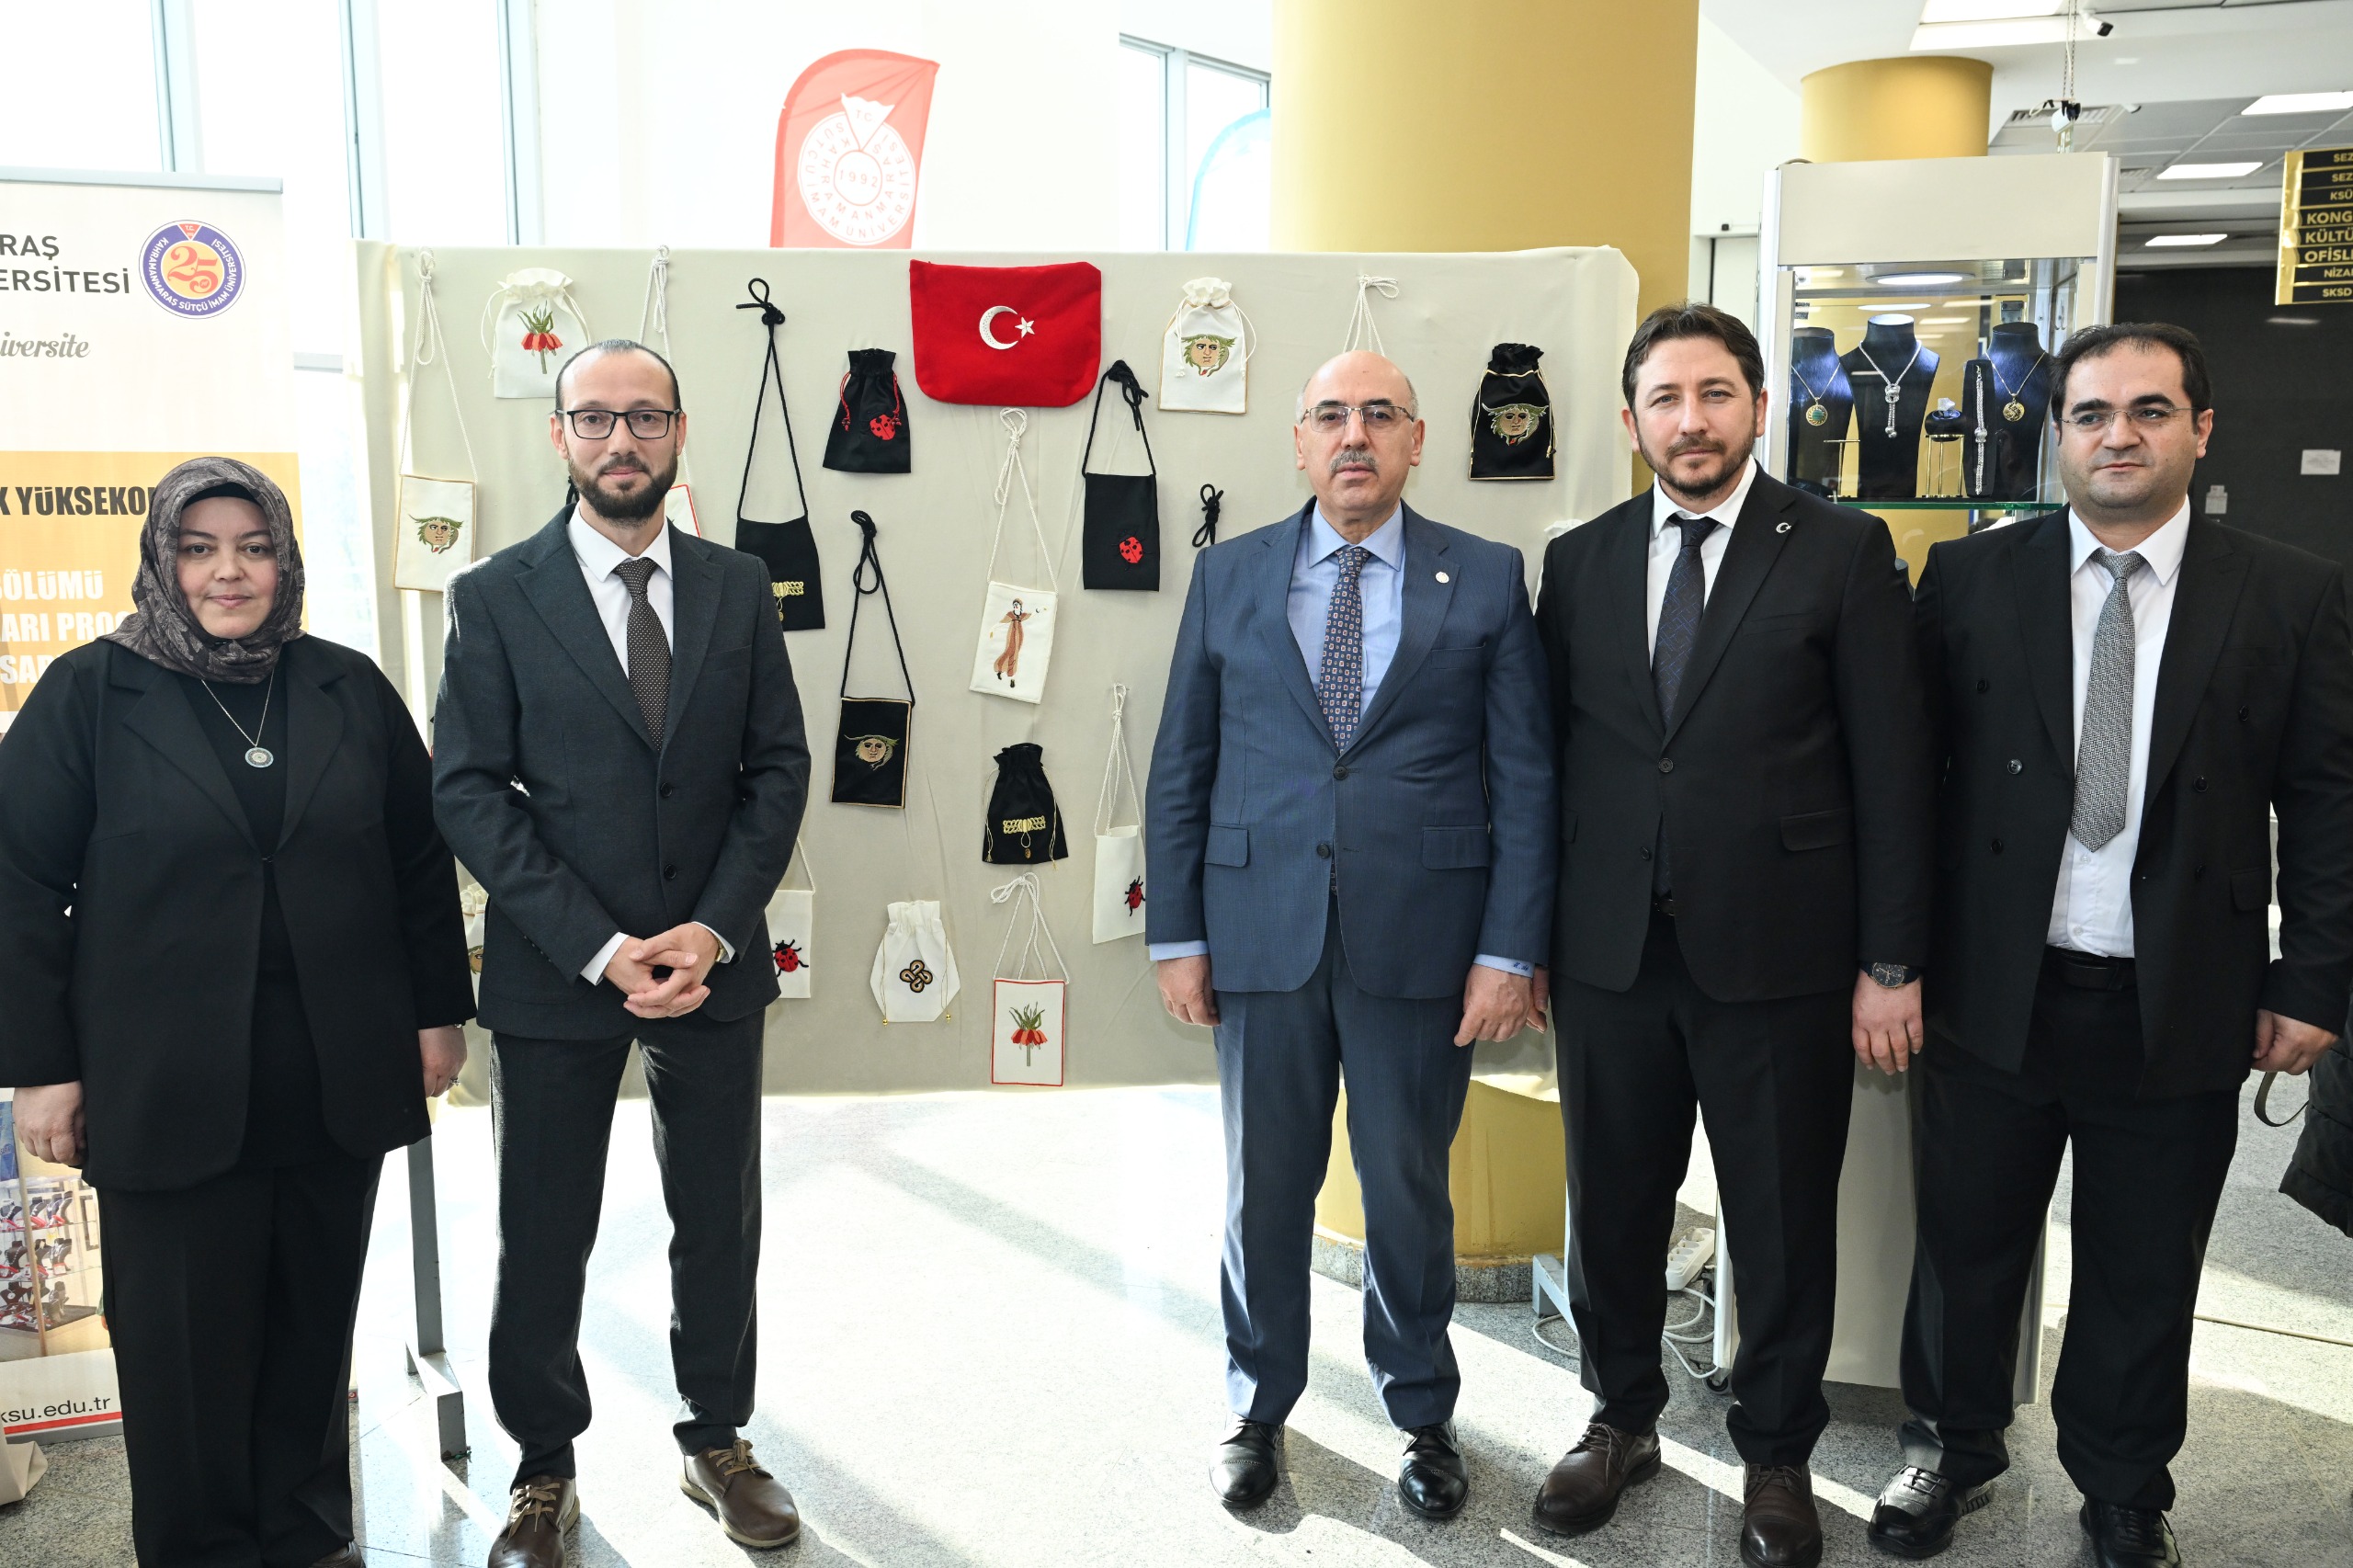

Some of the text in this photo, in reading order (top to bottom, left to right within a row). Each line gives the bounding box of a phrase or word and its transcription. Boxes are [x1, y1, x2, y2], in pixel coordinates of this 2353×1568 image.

[839, 169, 878, 187] 1992
[2330, 188, 2353, 200] KSÜ
[2306, 210, 2353, 225] KONG
[0, 233, 60, 260] RAŞ
[2305, 226, 2353, 244] KÜLTÜ
[148, 237, 237, 312] KAHRAMANMARAŞ SÜTÇÜ İMAM ÜNİVERSİTESİ
[167, 245, 218, 294] 25
[2322, 287, 2353, 298] SKSD
[0, 331, 91, 358] iversite
[15, 485, 156, 516] YÜKSEKO
[0, 569, 104, 600] ÖLÜMÜ
[1, 613, 51, 642] ARI
